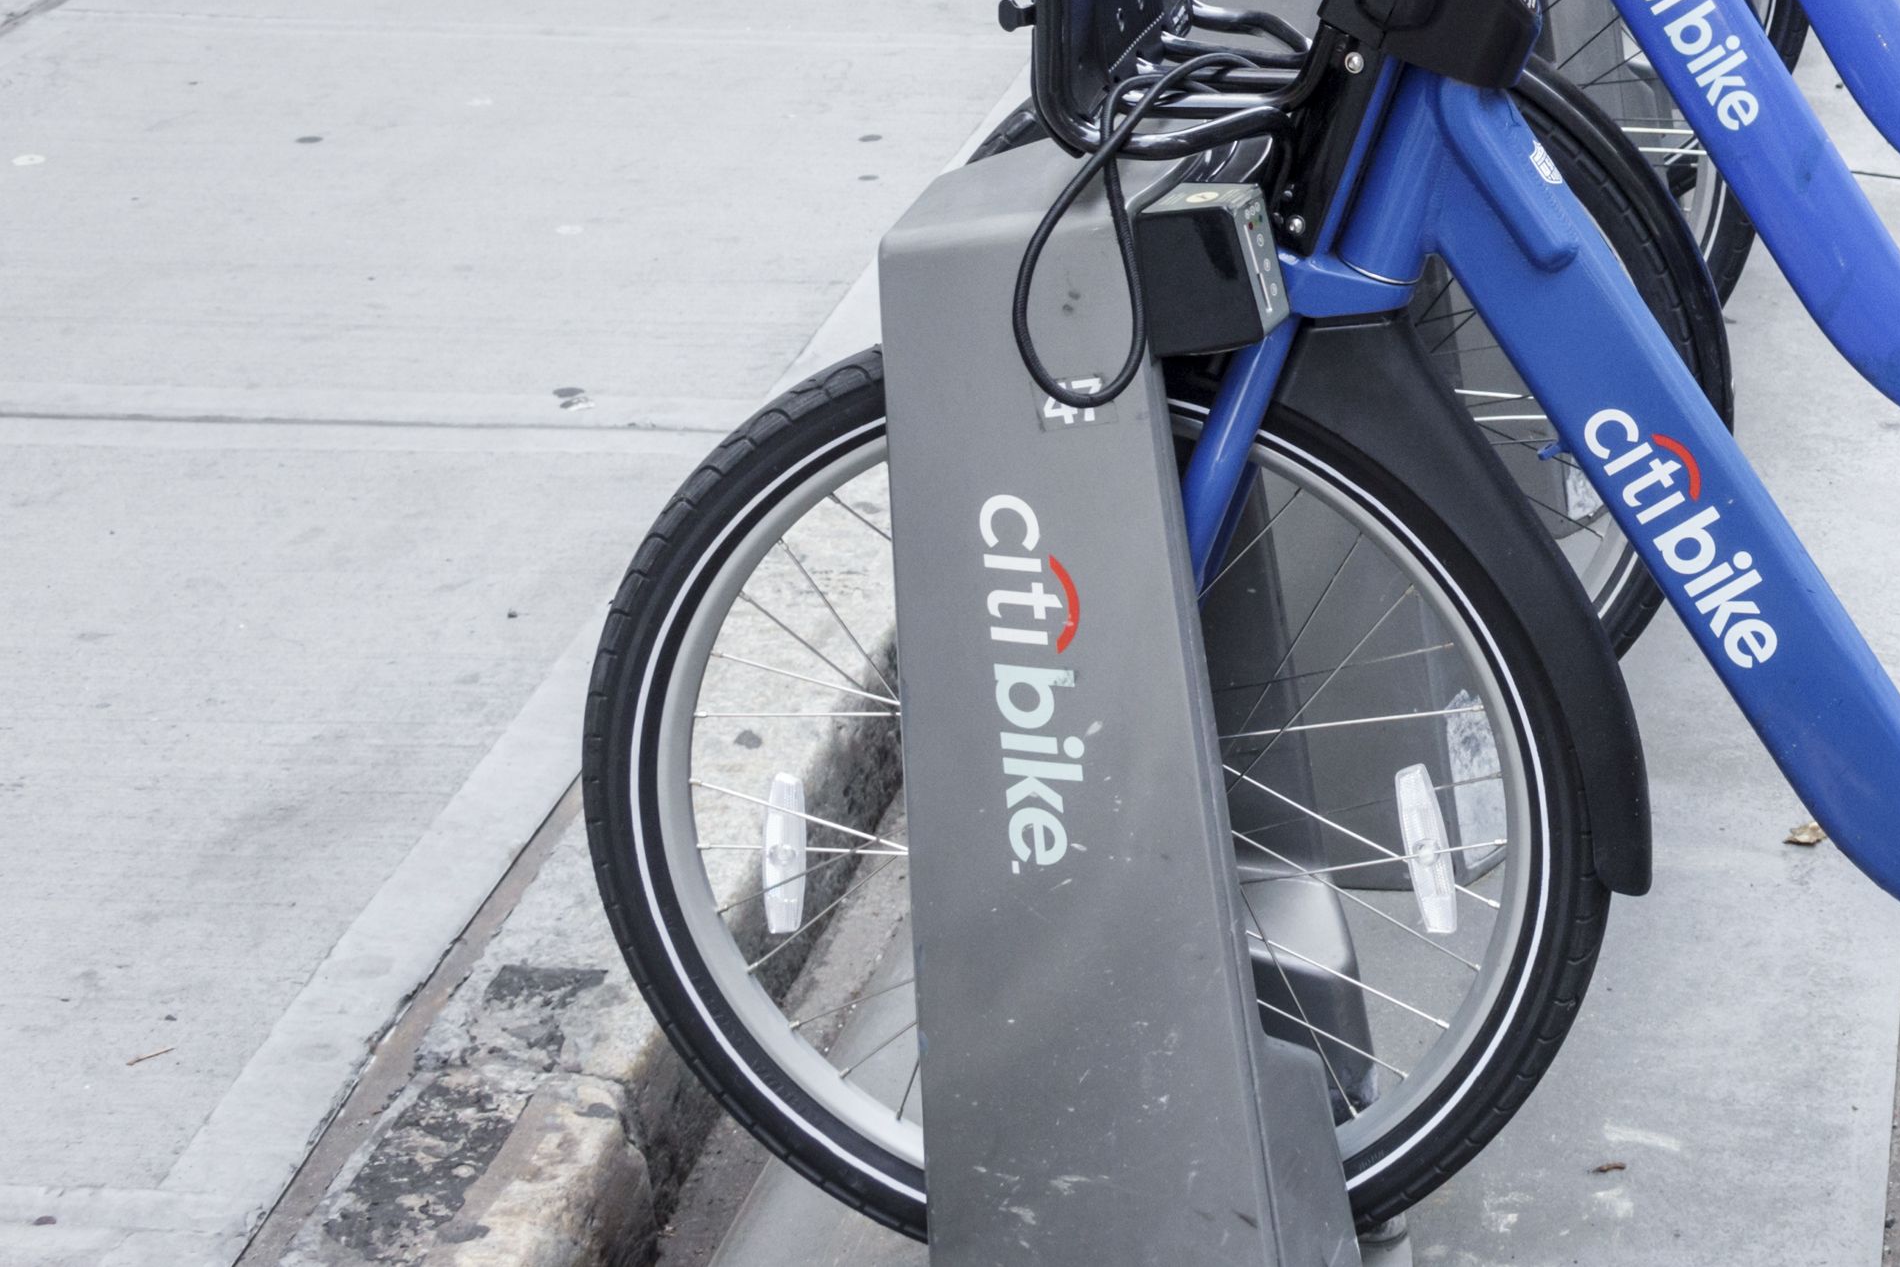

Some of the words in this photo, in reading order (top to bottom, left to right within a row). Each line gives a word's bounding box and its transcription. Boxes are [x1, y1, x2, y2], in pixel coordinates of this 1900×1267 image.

[1042, 377, 1103, 426] 47
[979, 494, 1080, 654] citi
[1584, 408, 1702, 526] citi
[1652, 505, 1778, 669] bike
[993, 662, 1086, 867] bike
